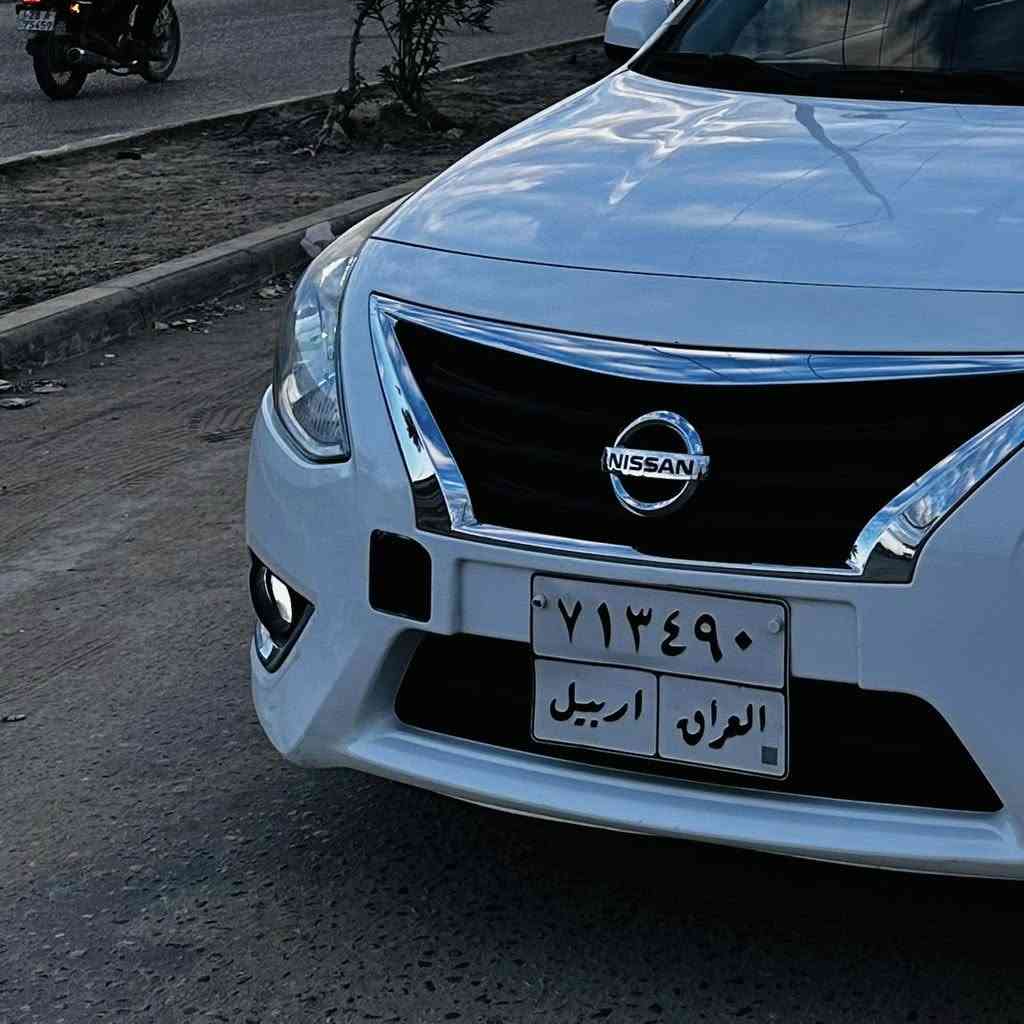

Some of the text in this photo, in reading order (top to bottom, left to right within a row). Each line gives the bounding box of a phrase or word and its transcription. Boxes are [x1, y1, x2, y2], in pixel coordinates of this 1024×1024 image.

[608, 453, 694, 475] NISSAN
[557, 598, 753, 663] ٧١٣٤٩٠
[677, 699, 767, 750] العراق
